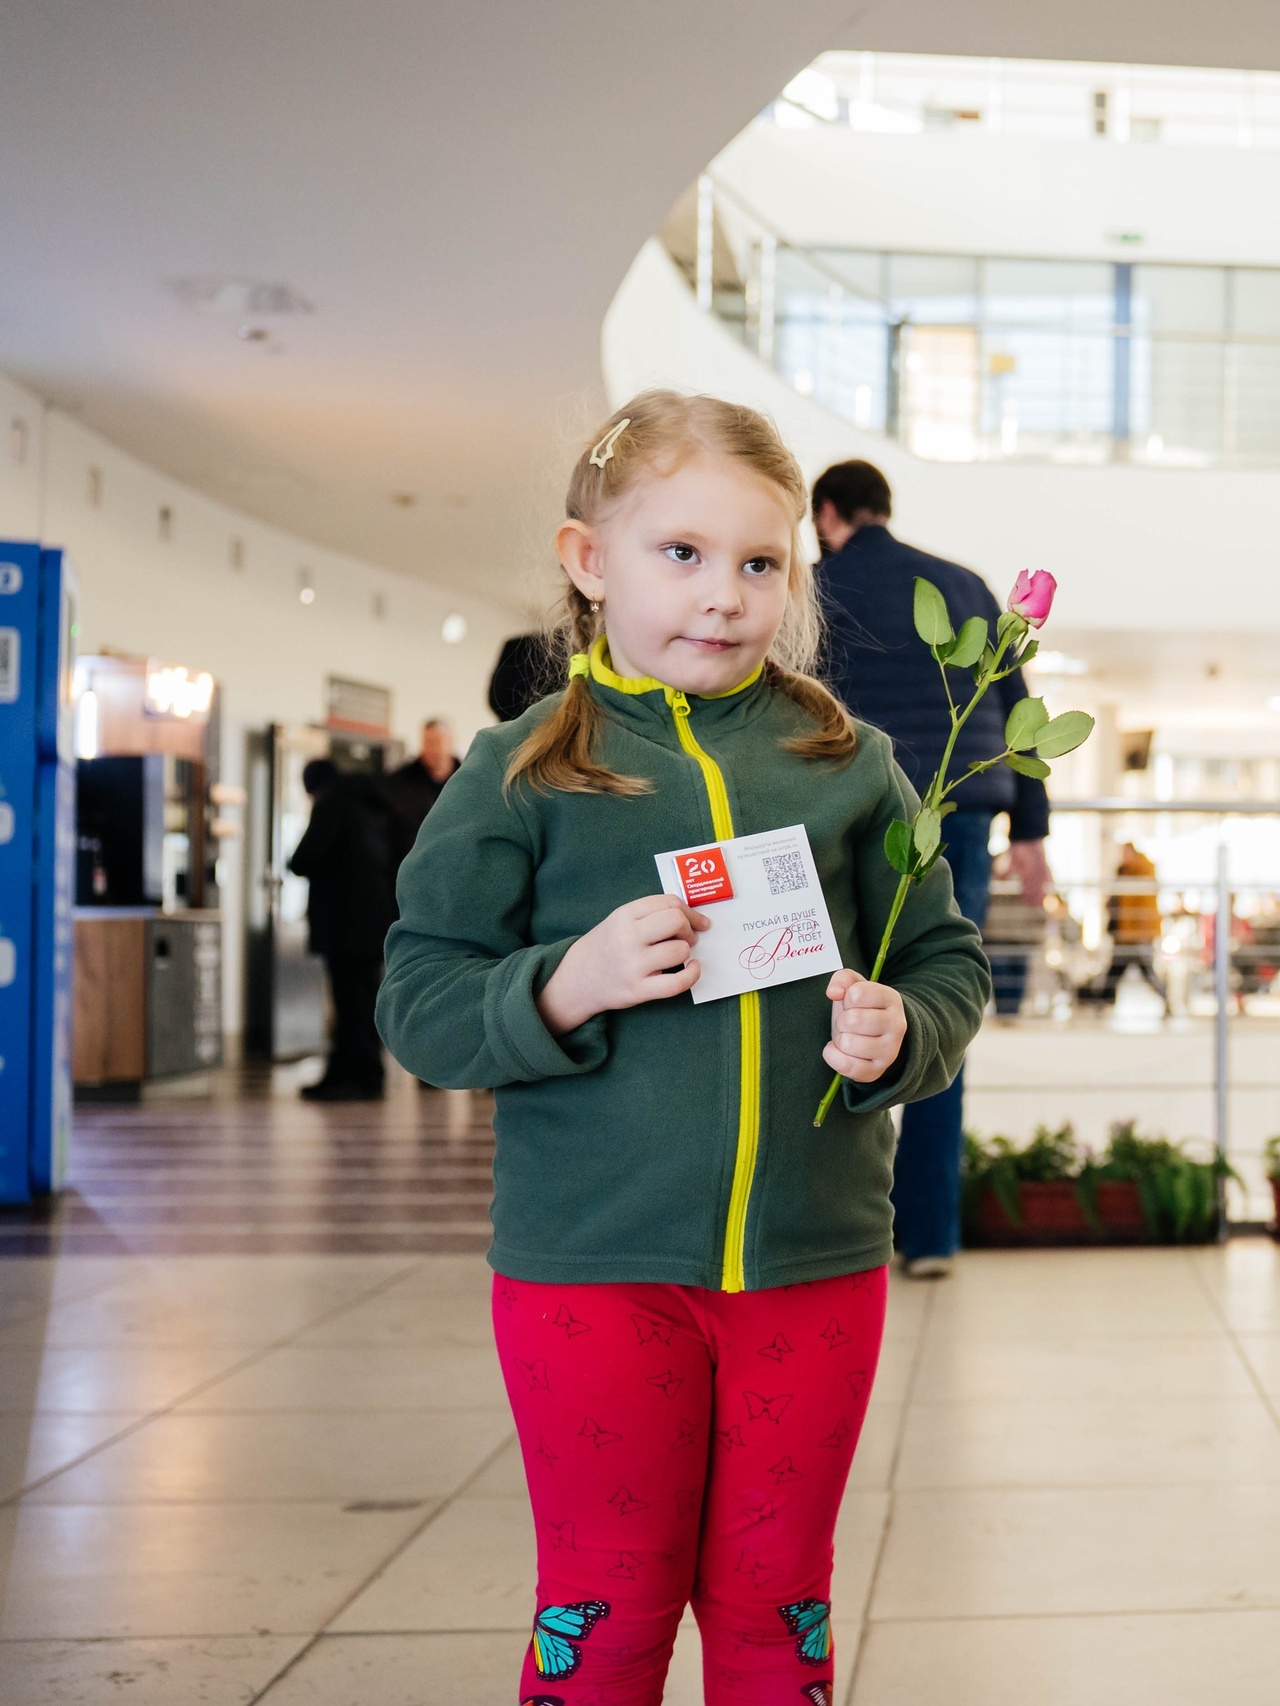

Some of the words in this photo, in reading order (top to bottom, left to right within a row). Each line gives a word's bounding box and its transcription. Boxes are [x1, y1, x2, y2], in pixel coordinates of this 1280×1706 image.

[685, 858, 716, 877] 20
[742, 915, 781, 931] ПУСКАЙ
[782, 914, 789, 923] В
[791, 908, 817, 922] ДУШЕ
[798, 931, 822, 943] ПОЕТ
